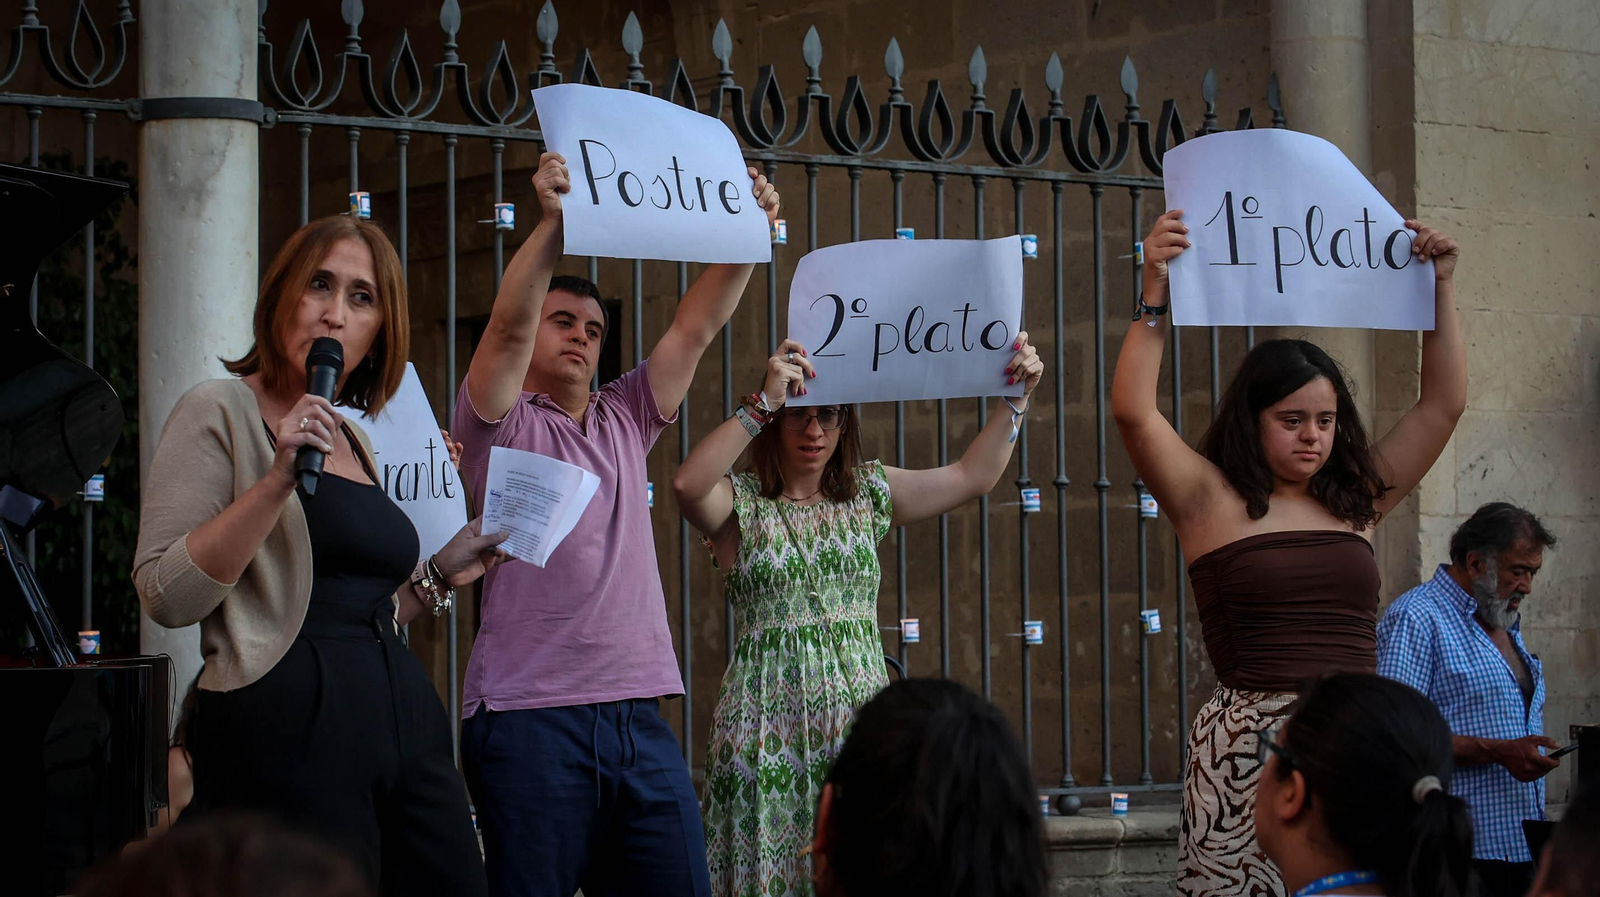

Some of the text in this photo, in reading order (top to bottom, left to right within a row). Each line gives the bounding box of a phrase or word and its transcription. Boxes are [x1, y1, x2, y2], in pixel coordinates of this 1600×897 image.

[578, 138, 741, 215] Postre
[1272, 205, 1412, 293] plato
[872, 302, 1009, 373] plato
[374, 437, 456, 502] rante
